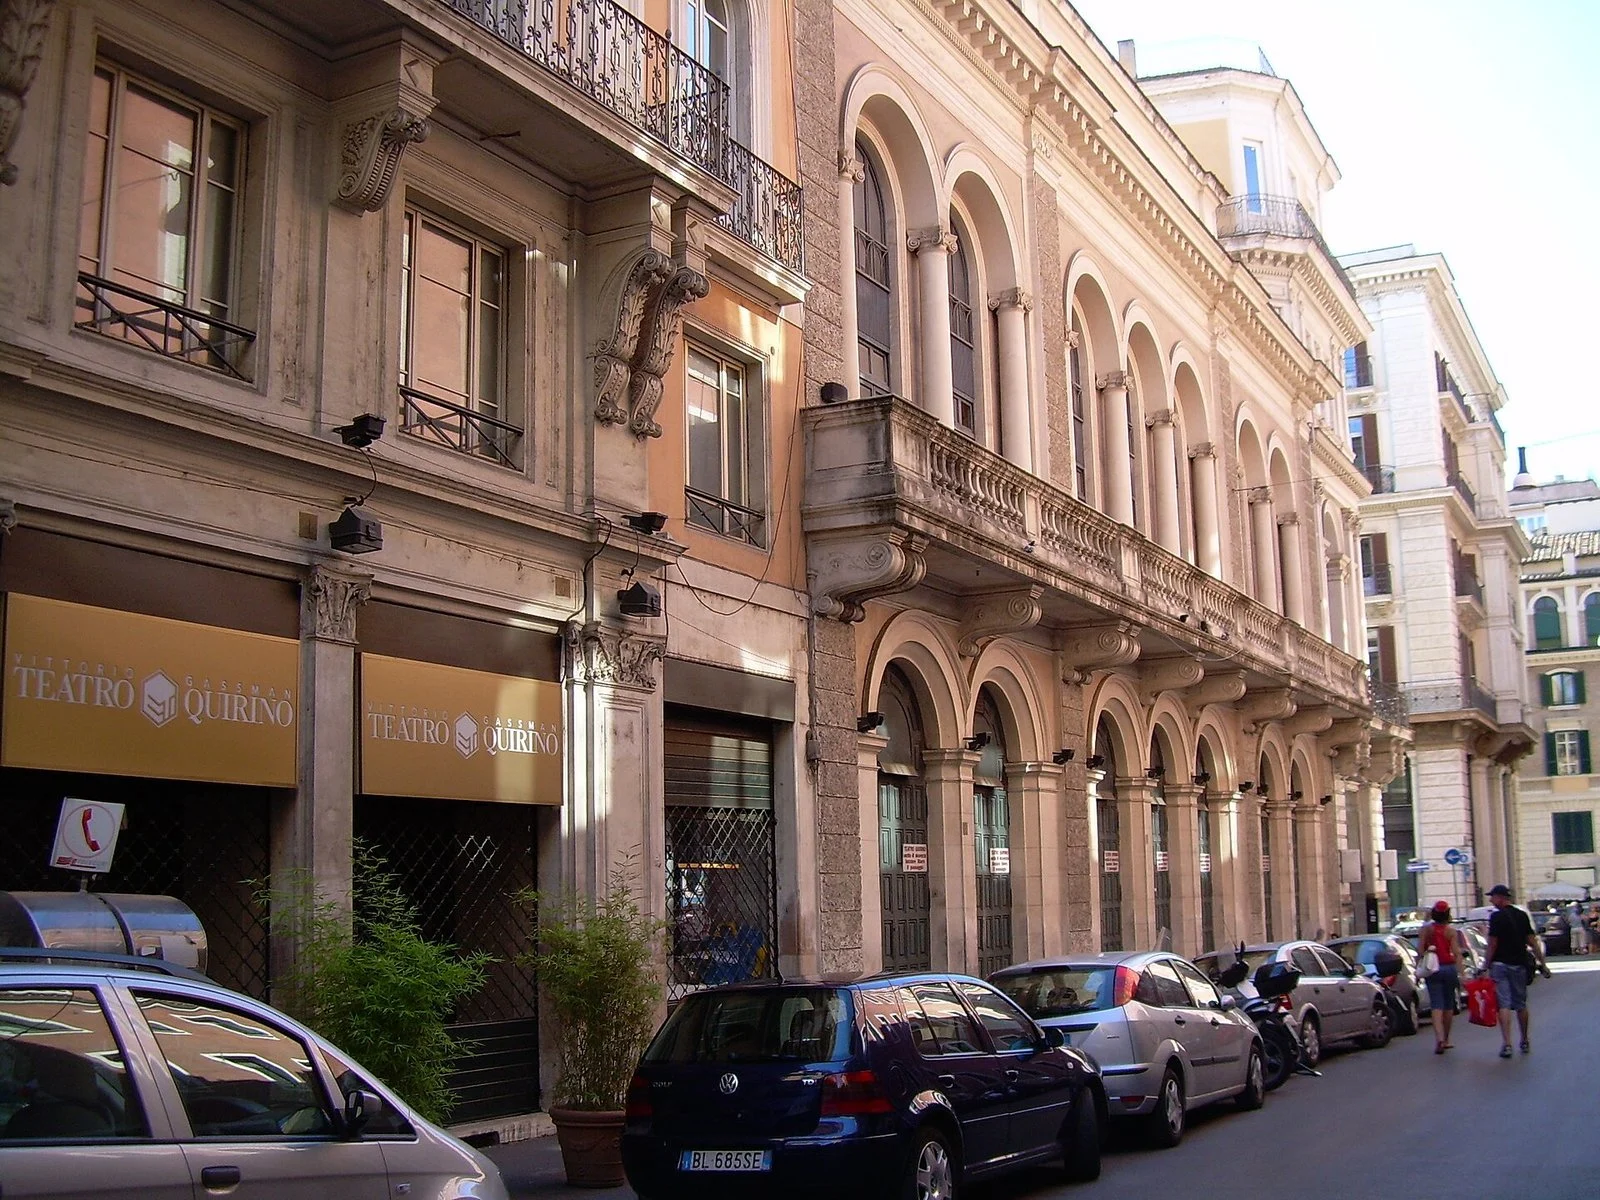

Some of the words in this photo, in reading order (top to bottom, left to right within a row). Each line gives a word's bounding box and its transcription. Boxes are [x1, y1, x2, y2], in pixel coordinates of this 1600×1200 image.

[14, 666, 135, 710] TEATRO
[184, 688, 294, 728] QUIRINO
[15, 653, 135, 680] VITTORIO
[184, 674, 292, 700] GASSMAN
[367, 702, 449, 720] VITTORIO
[483, 715, 558, 733] GASSMAN
[368, 712, 450, 746] TEATRO
[483, 726, 559, 757] QUIRINO
[692, 1152, 709, 1168] BL
[714, 1152, 762, 1169] 685SE
